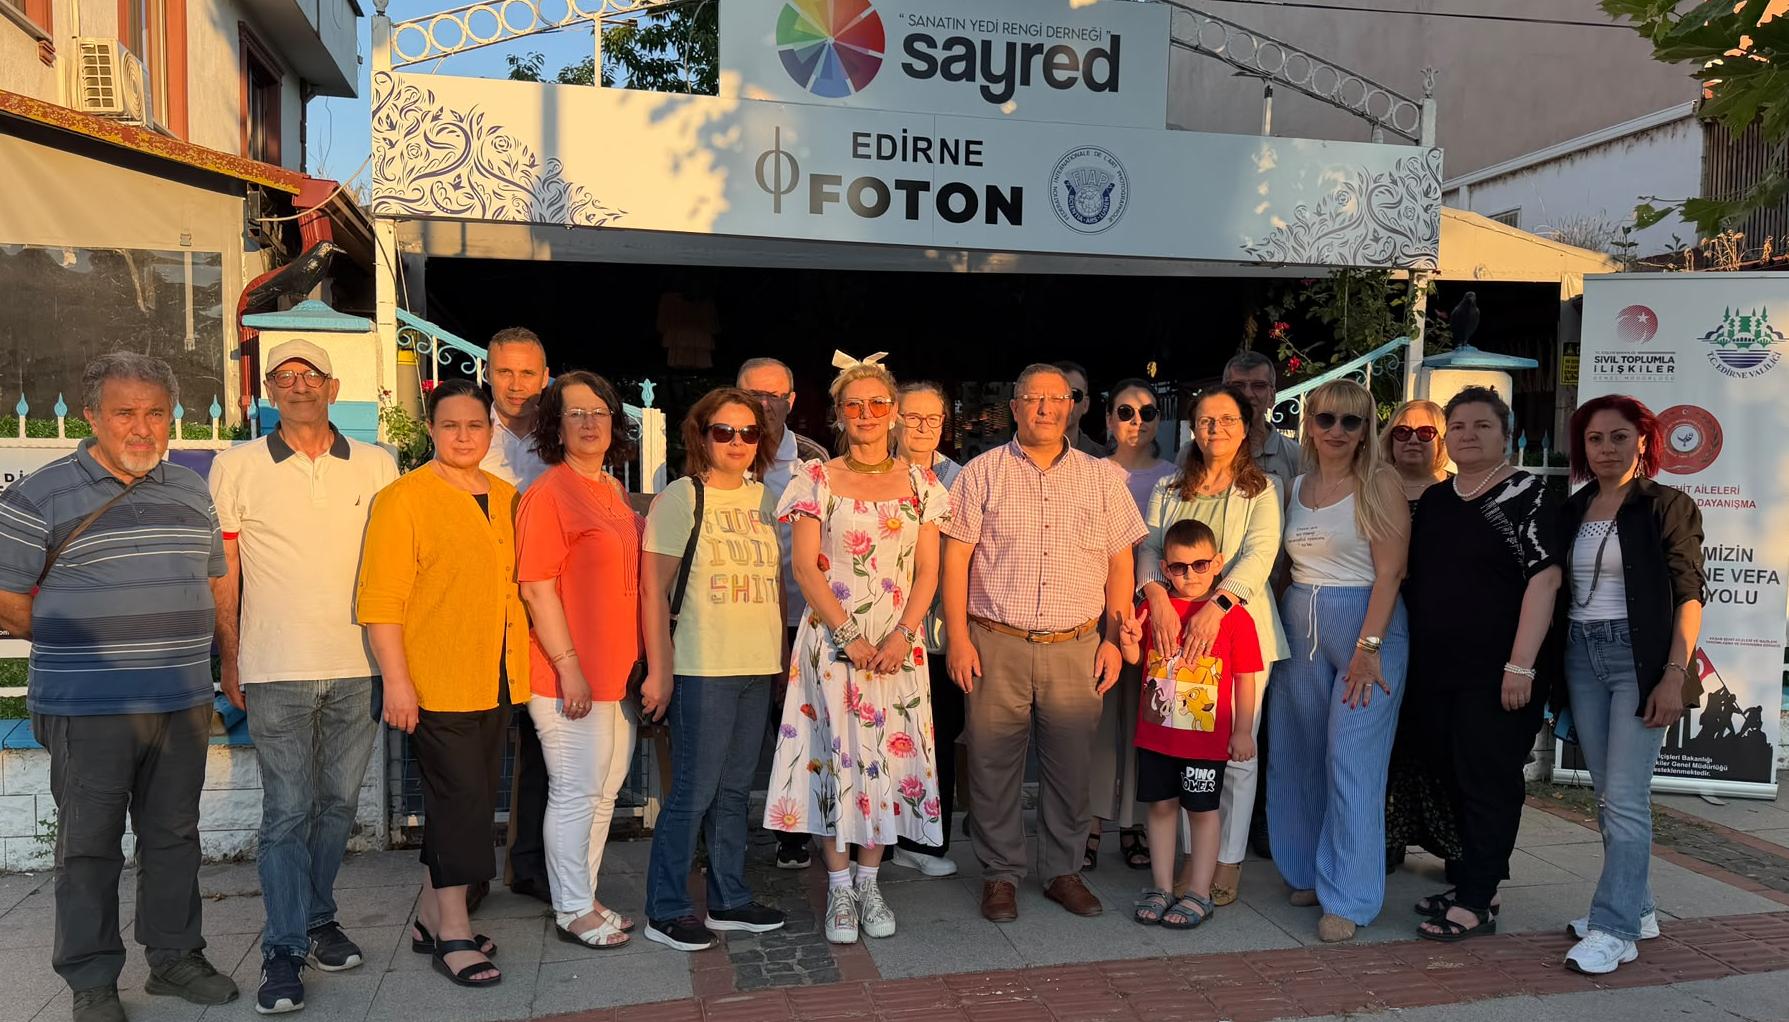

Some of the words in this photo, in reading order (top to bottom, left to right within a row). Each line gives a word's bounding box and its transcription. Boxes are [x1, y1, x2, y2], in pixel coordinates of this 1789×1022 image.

[908, 14, 966, 32] SANATIN
[970, 18, 999, 33] YEDİ
[1002, 22, 1043, 37] RENGİ
[1046, 26, 1103, 42] DERNEĞİ
[901, 32, 1121, 104] sayred
[852, 128, 984, 167] EDİRNE
[1071, 168, 1110, 188] FIAP
[809, 173, 1024, 226] FOTON
[1620, 355, 1675, 364] TOPLUMLA
[1715, 363, 1749, 379] EDİRNE
[1694, 483, 1740, 495] AİLELERİ
[1697, 498, 1757, 510] DAYANIŞMA
[1703, 544, 1754, 562] MİZİN
[1703, 567, 1725, 582] NE
[1731, 568, 1780, 585] VEFA
[1653, 767, 1712, 777] esteklenmektedir.
[1671, 760, 1691, 768] Genel
[1186, 766, 1216, 780] DINO
